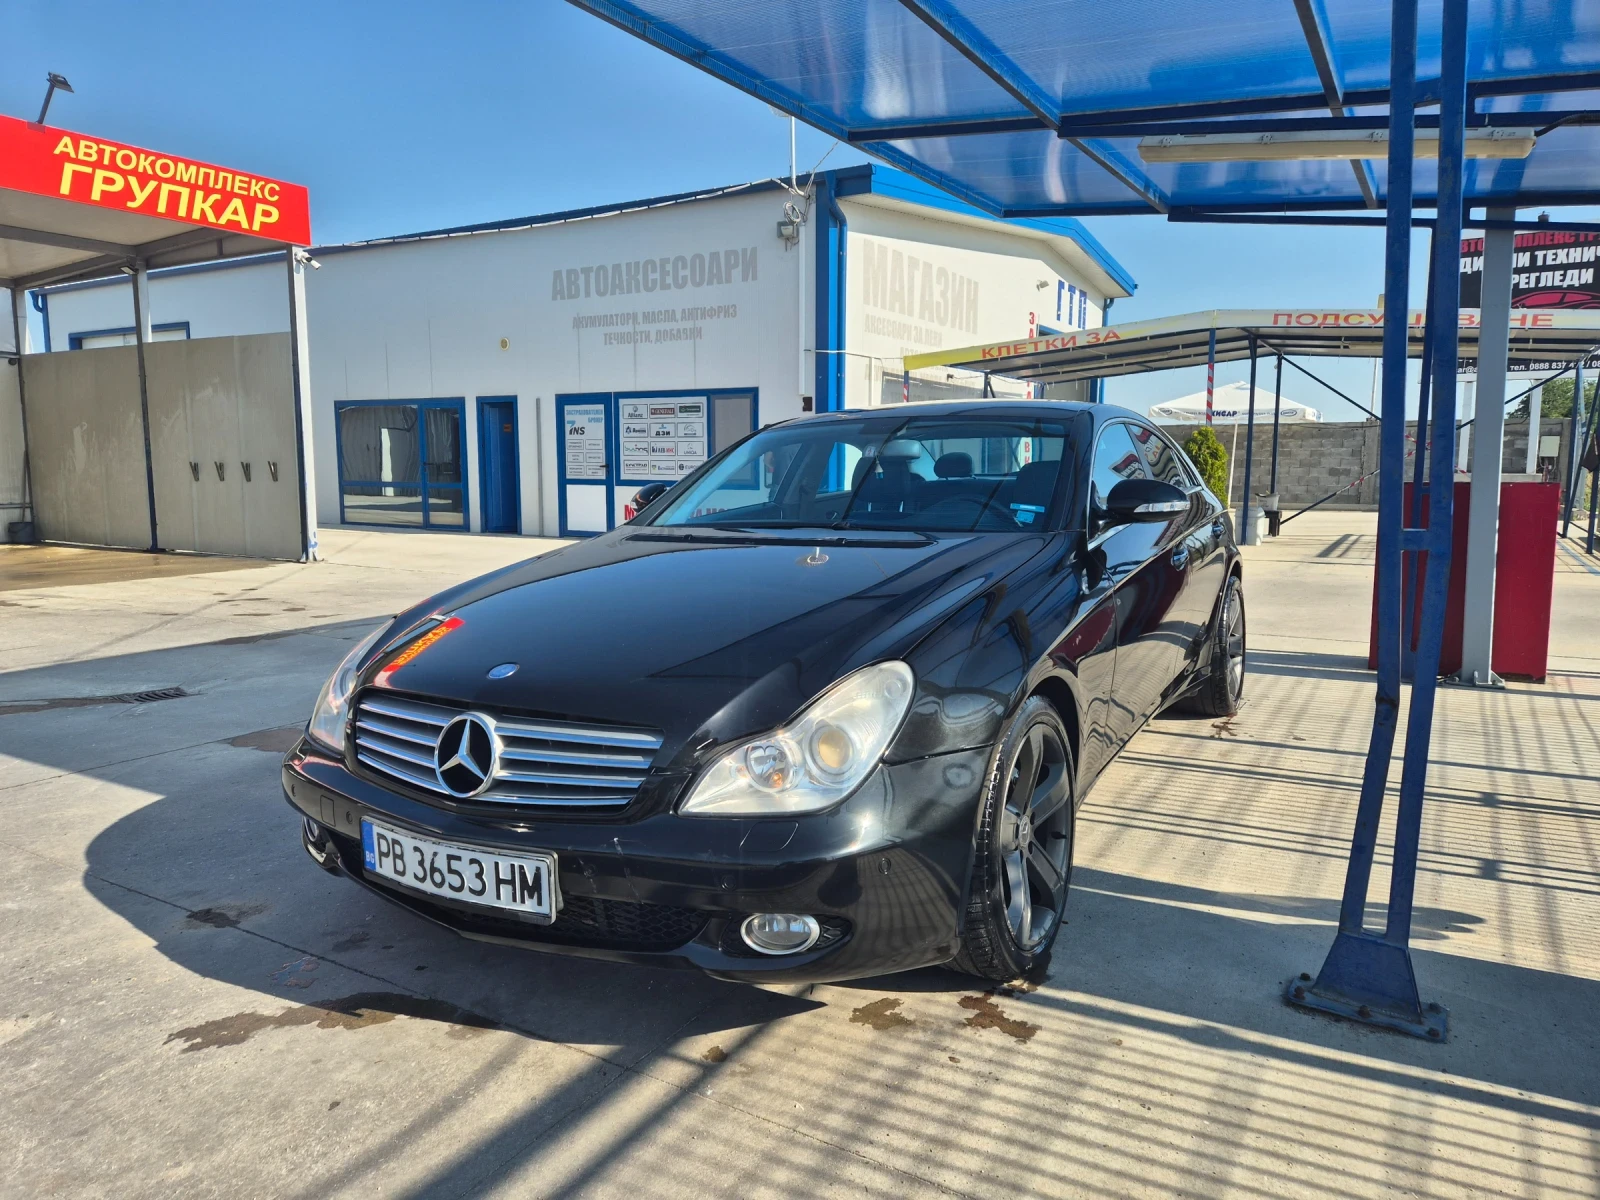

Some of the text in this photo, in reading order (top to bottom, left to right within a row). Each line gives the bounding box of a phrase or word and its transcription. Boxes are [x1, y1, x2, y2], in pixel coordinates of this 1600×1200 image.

[53, 135, 281, 202] АВТОКОМПЛЕКС
[59, 162, 280, 232] ГРУПКАР
[551, 246, 759, 302] АВТОАКСЕСОАРИ
[862, 237, 980, 335] МАГАЗИН
[1511, 268, 1594, 289] РЕГЛЕДИ
[572, 304, 737, 330] АКУМУЛАТОРИ, МАСЛА, АНТИФРИЗ
[1056, 279, 1087, 331] ГТП
[603, 326, 703, 346] ТЕЧНОСТИ, ДОБАВКИ
[864, 313, 912, 342] АКСЕСОАРИ
[914, 325, 923, 345] ЗА
[981, 329, 1121, 359] КЛЕТКИ ЗА
[1529, 361, 1549, 371] 0888
[366, 850, 375, 864] BG
[376, 832, 543, 907] PB 3653 HM
